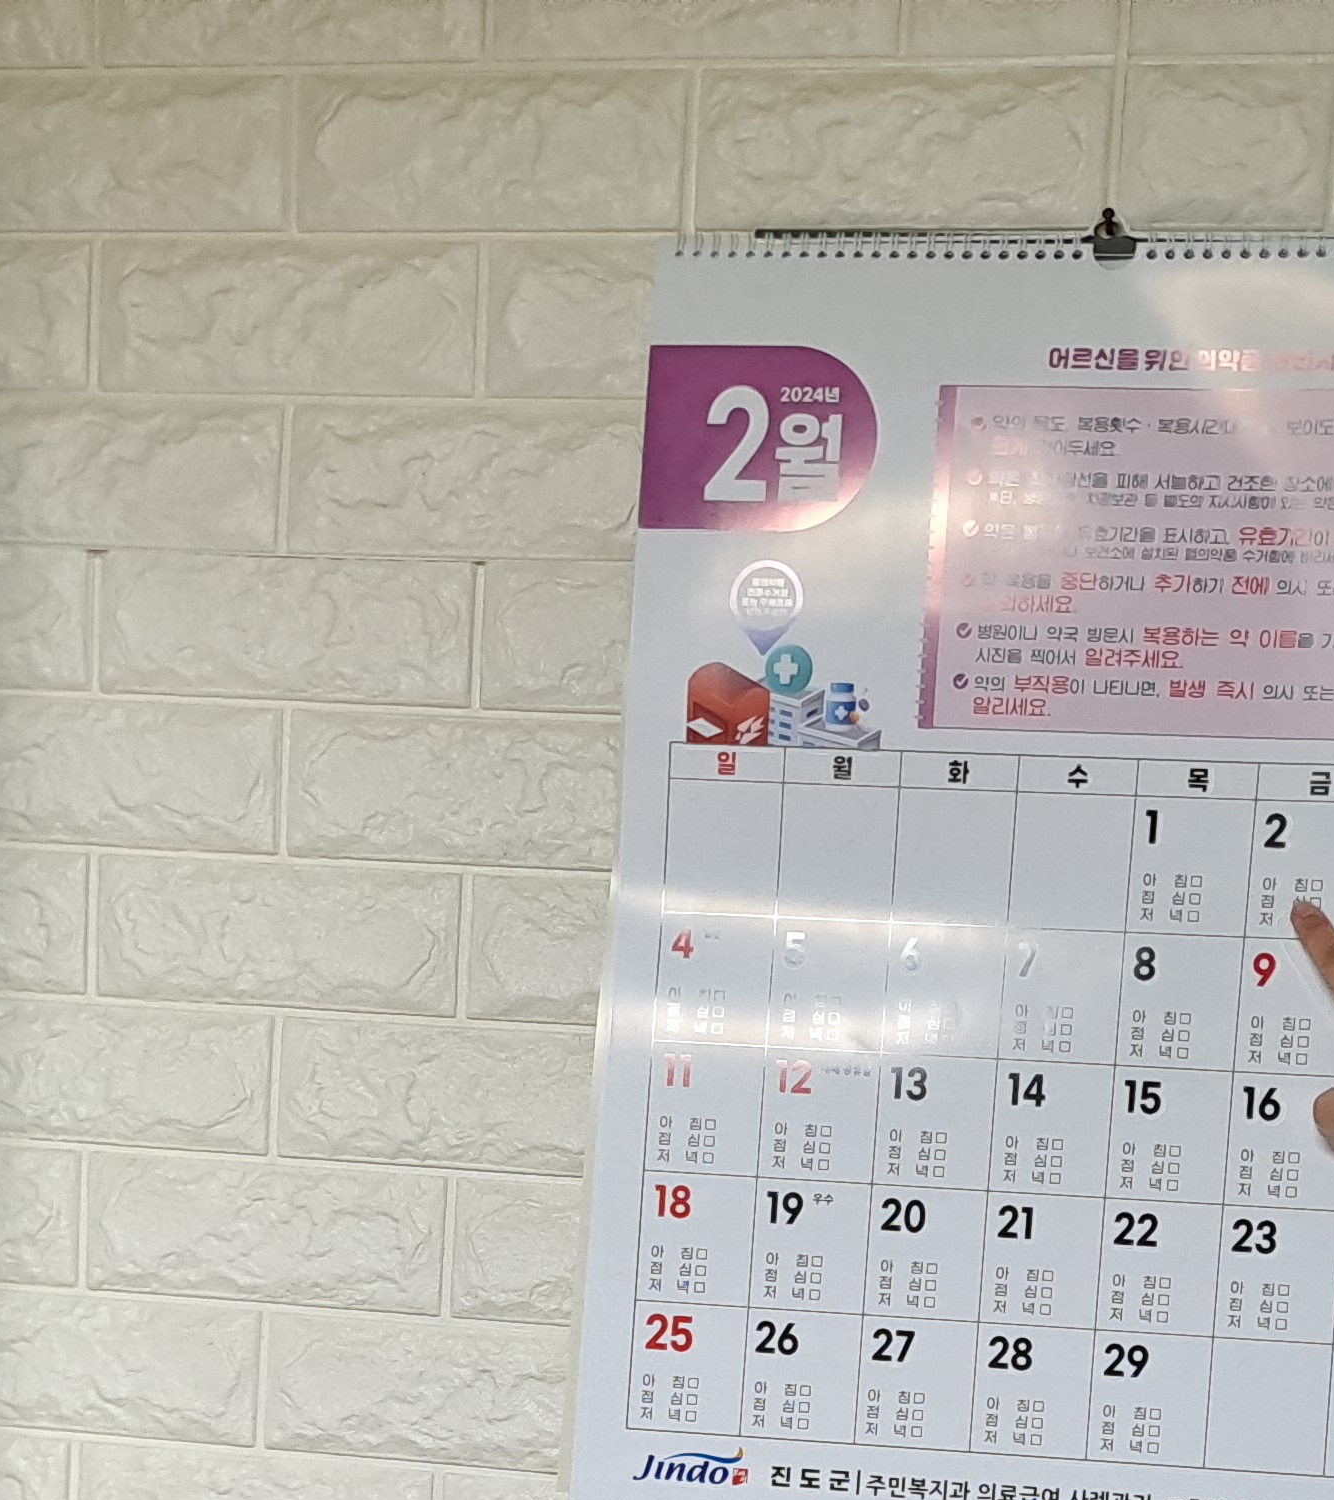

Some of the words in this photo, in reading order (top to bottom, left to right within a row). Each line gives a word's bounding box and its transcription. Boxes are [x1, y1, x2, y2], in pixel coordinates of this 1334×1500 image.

[1049, 347, 1139, 371] 어르신을
[780, 386, 841, 404] 2024년
[1117, 472, 1149, 489] 피해
[1154, 473, 1220, 492] 서늘하고
[1227, 475, 1276, 492] 건조한
[1284, 475, 1333, 493] 장소에
[1239, 527, 1330, 547] 유효기간이
[1140, 546, 1179, 561] 설치된
[1061, 572, 1145, 592] 중단하거나
[1154, 574, 1224, 594] 추가하기
[1231, 576, 1270, 596] 전에
[1276, 579, 1308, 597] 의사
[978, 624, 1039, 642] 병원이나
[1047, 626, 1079, 643] 약국
[1087, 627, 1134, 645] 방문시
[1143, 626, 1220, 647] 복용하는
[1230, 629, 1249, 648] 약
[1259, 629, 1315, 649] 이름을
[1030, 649, 1076, 666] 찍어서
[974, 676, 1006, 693] 약의
[1014, 675, 1085, 695] 부작용이
[1093, 679, 1160, 699] 나타나면,
[1169, 679, 1206, 699] 발생
[1217, 681, 1254, 700] 즉시
[1262, 684, 1294, 701] 의사
[1303, 685, 1334, 702] 또는
[973, 697, 1052, 717] 알리세요.
[717, 752, 736, 775] 일
[833, 756, 852, 780] 월
[948, 760, 969, 784] 화
[1067, 764, 1088, 788] 수
[1188, 768, 1210, 792] 목
[1310, 772, 1332, 796] 금
[1146, 809, 1158, 844] 1
[1264, 813, 1287, 849] 2
[671, 928, 694, 959] 4
[784, 931, 806, 969] 5
[900, 937, 922, 975] 6
[1017, 942, 1038, 978] 7
[1133, 947, 1156, 981] 8
[1253, 953, 1276, 987] 9
[666, 1053, 691, 1088] 11
[776, 1060, 812, 1094] 12
[890, 1067, 927, 1100] 13
[1008, 1072, 1046, 1107] 14
[1125, 1080, 1162, 1115] 15
[1243, 1086, 1281, 1121] 16
[655, 1184, 691, 1218] 18
[767, 1191, 804, 1225] 19
[812, 1193, 834, 1206] 우수
[881, 1198, 926, 1233] 20
[997, 1205, 1034, 1239] 21
[1114, 1212, 1158, 1247] 22
[1231, 1219, 1277, 1254] 23
[645, 1313, 693, 1352] 25
[755, 1320, 799, 1355] 26
[872, 1328, 916, 1362] 27
[988, 1336, 1033, 1371] 28
[1104, 1343, 1149, 1378] 29
[633, 1453, 729, 1486] Jindo
